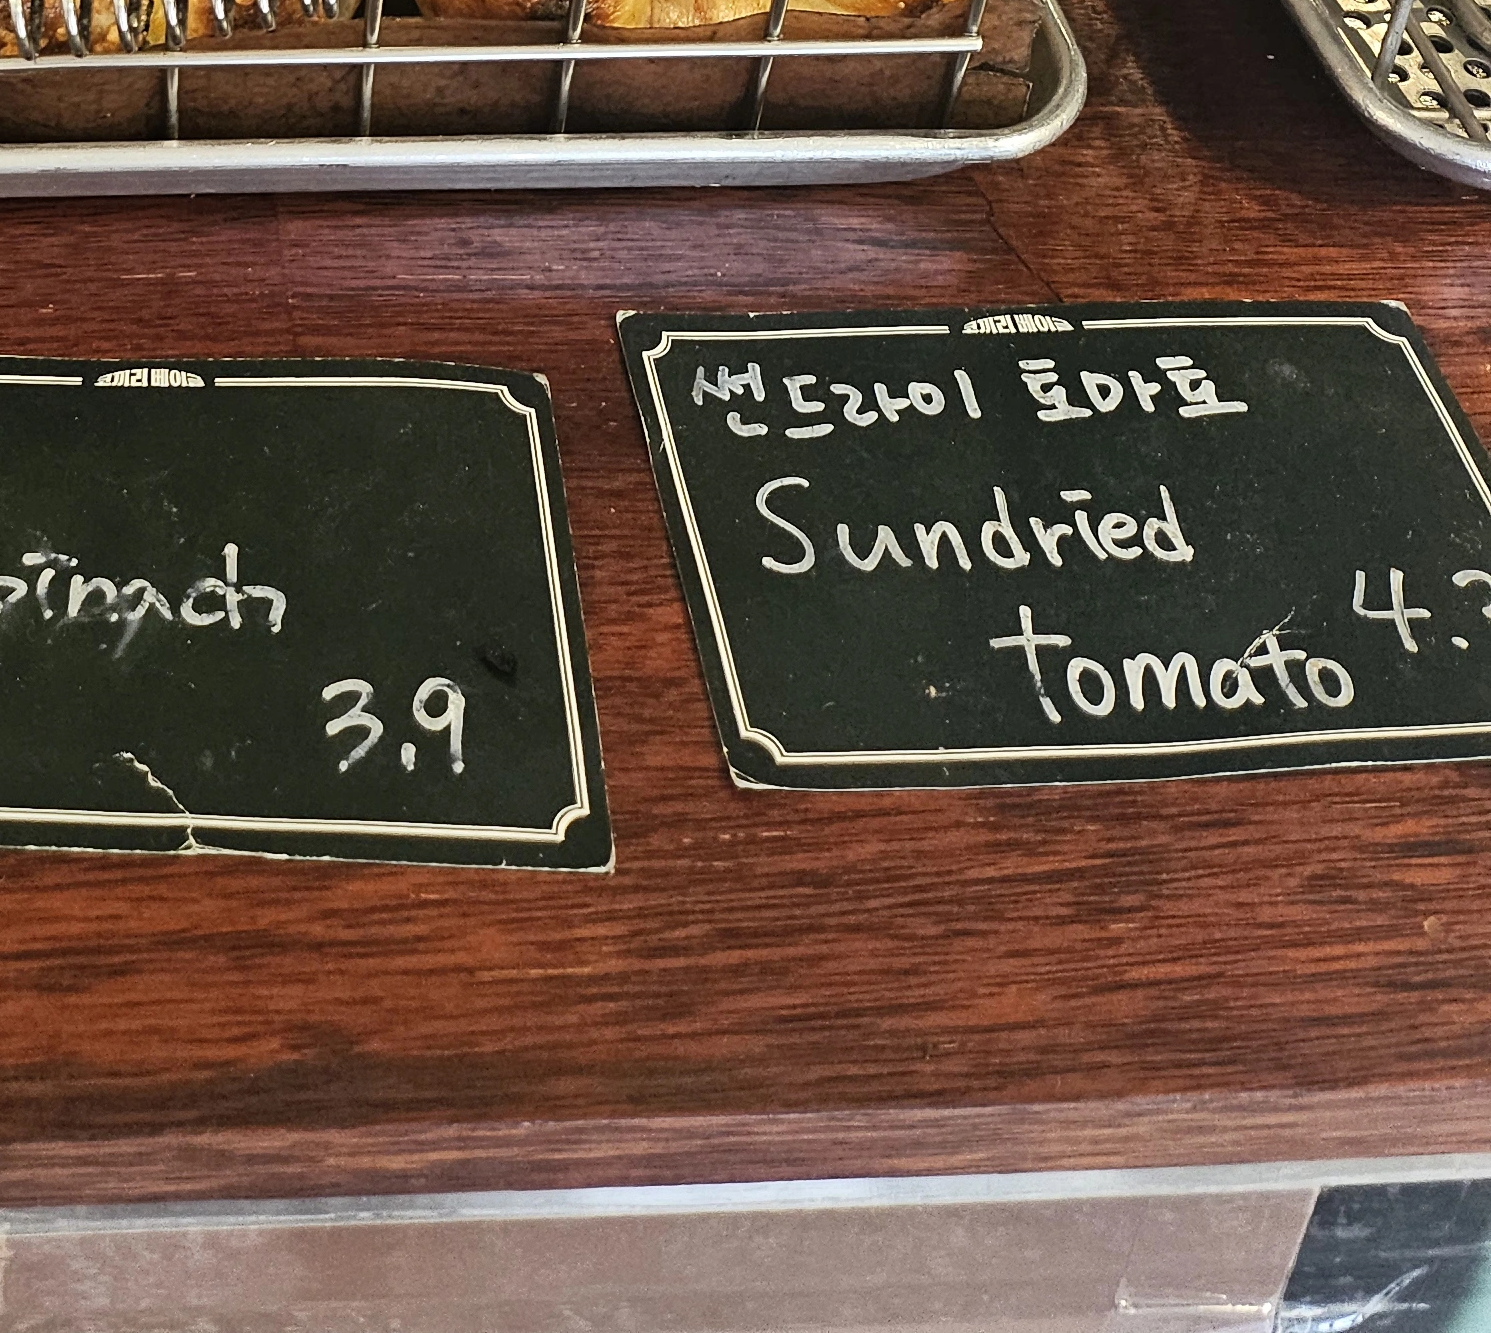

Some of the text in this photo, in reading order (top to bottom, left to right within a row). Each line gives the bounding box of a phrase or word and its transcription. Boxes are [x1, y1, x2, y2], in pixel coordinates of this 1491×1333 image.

[1018, 355, 1249, 420] 토마토
[754, 475, 1195, 574] Sundried
[989, 605, 1355, 726] tomato
[320, 675, 466, 775] 3.9
